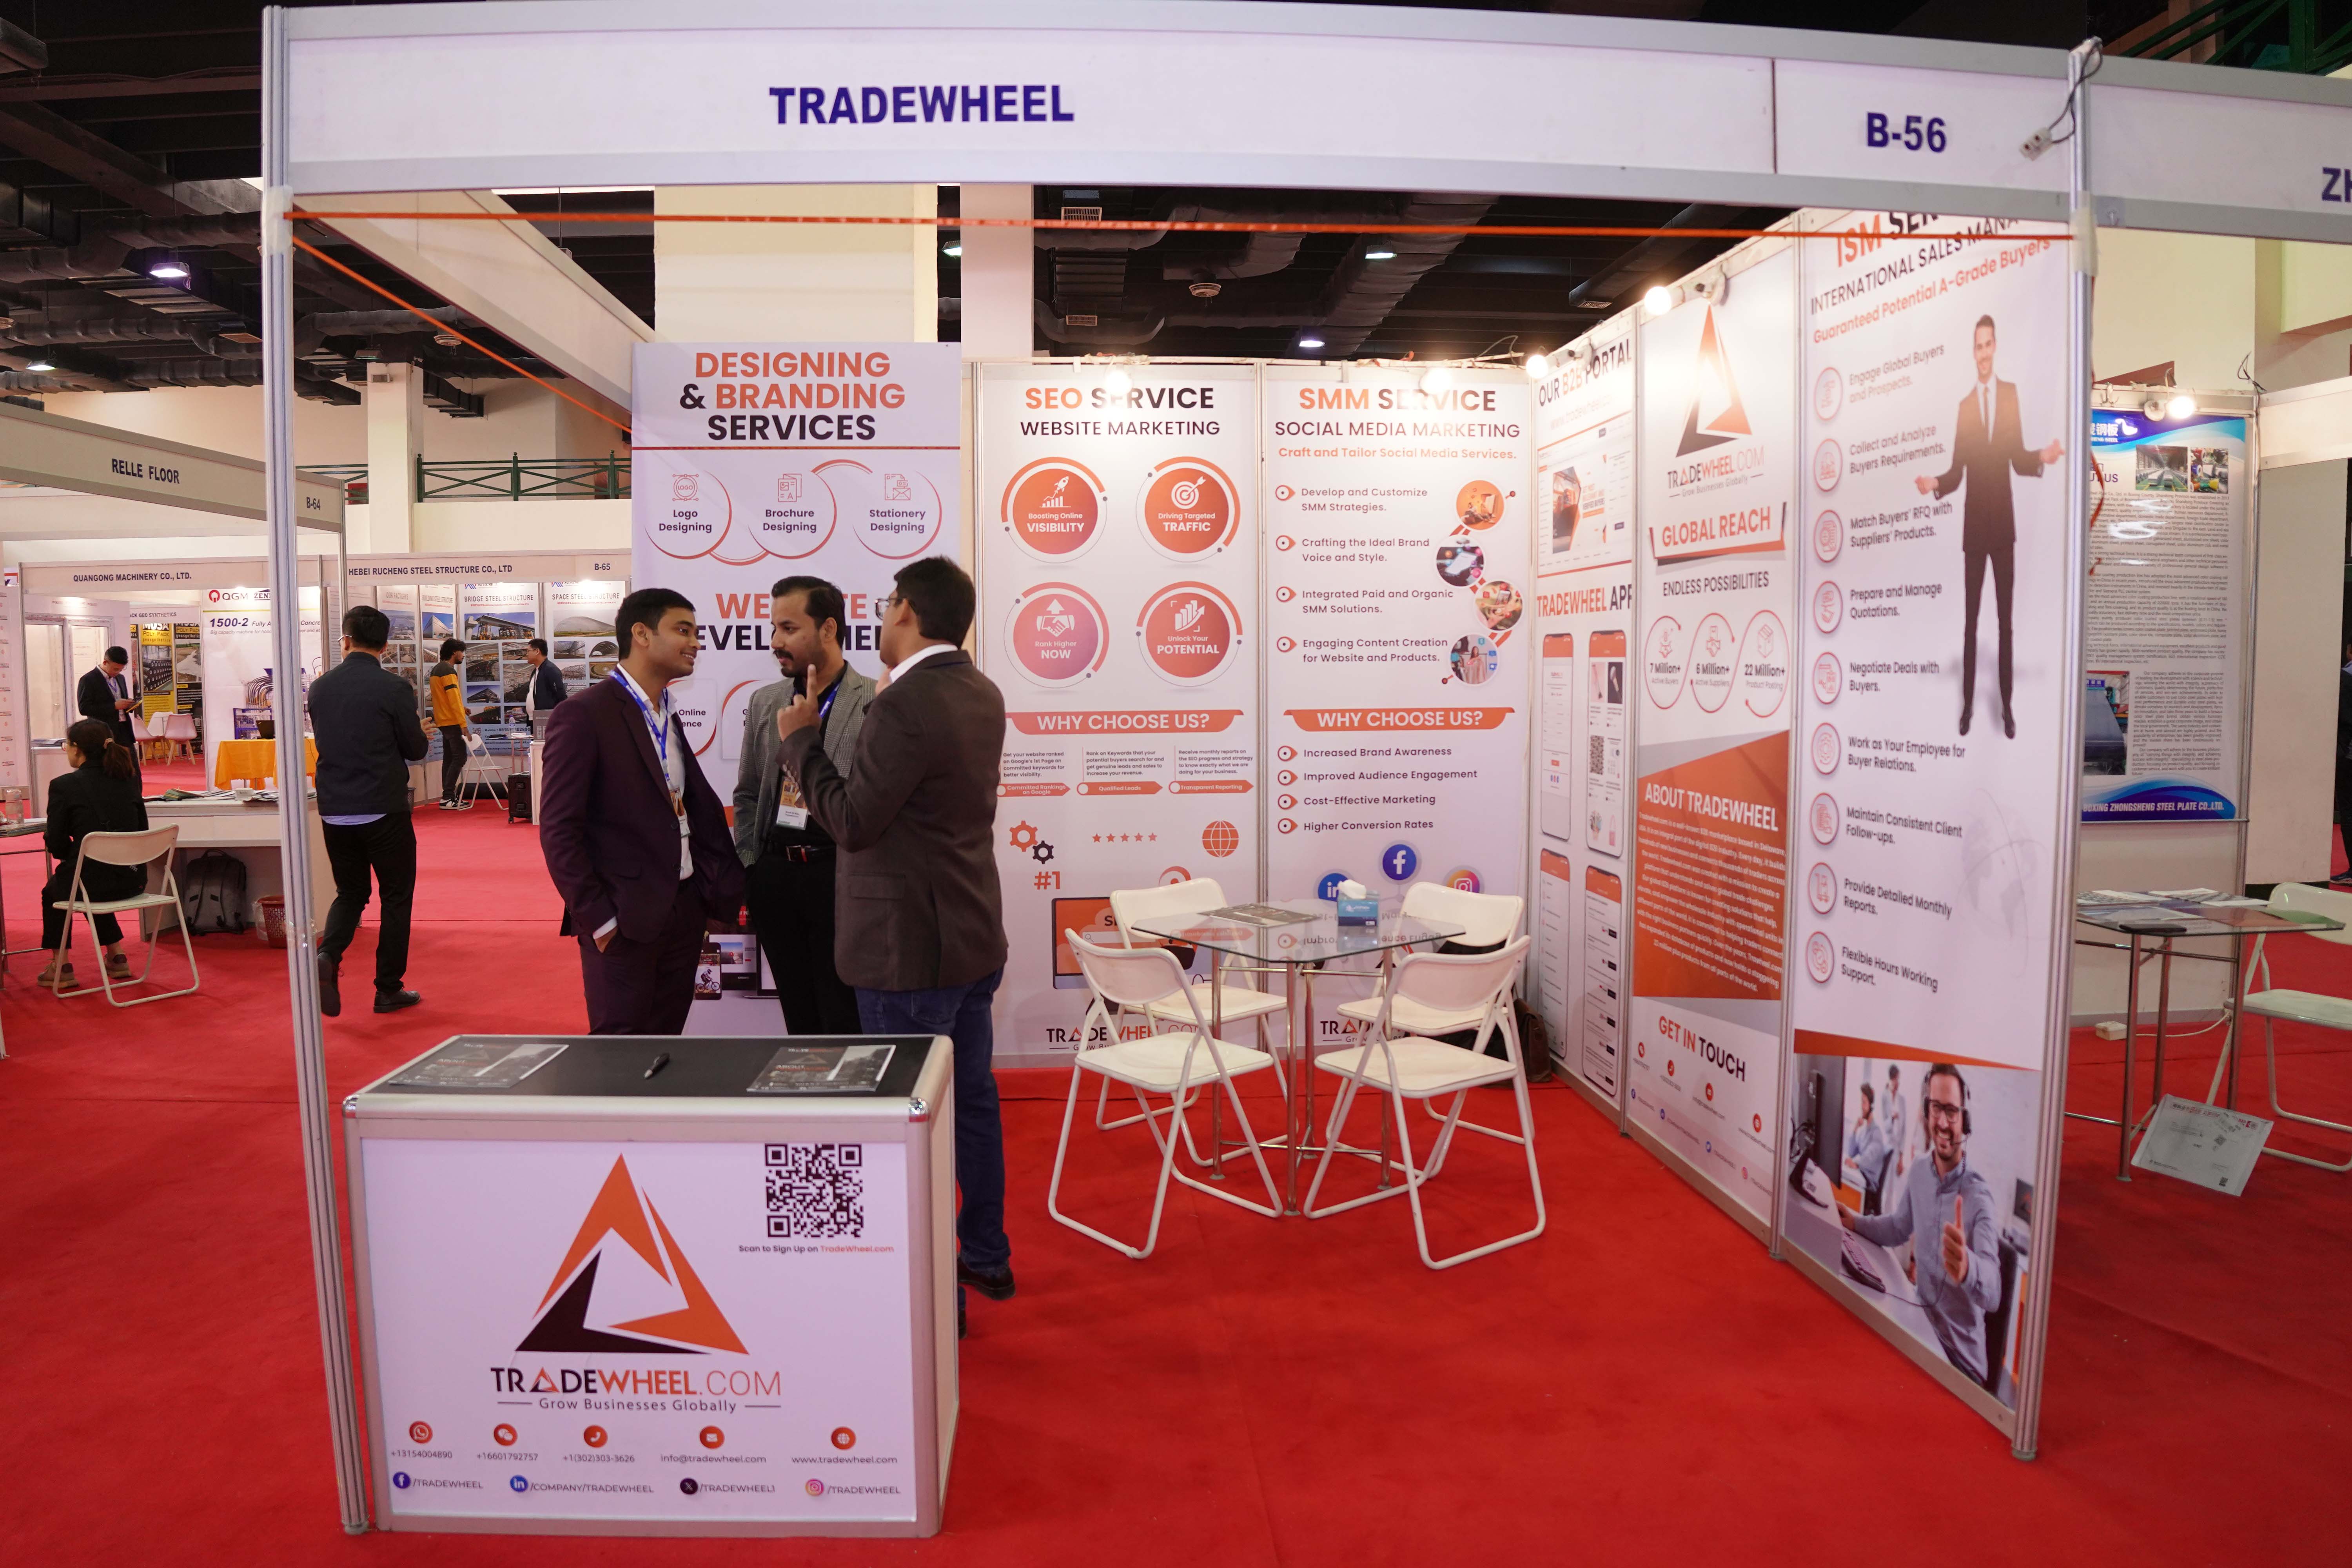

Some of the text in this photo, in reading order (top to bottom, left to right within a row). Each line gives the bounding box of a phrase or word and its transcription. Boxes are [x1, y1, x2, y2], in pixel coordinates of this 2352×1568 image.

[769, 85, 1074, 124] TRADEWHEEL
[1867, 112, 1947, 153] B-56
[1811, 230, 1963, 317] INTERNATIONAL SALES
[1813, 240, 2051, 343] Guaranteed Potential A-Grade Buyers
[696, 352, 890, 377] DESIGNING
[680, 383, 905, 409] & BRANDING
[1026, 388, 1082, 409] SEO
[1300, 388, 1368, 409] SMM
[708, 415, 875, 440] SERVICES
[1020, 421, 1220, 435] WEBSITE MARKETING
[1276, 422, 1520, 437] SOCIAL MEDIA MARKETING
[1279, 447, 1516, 459] Craft and Tailor Social Media Services.
[112, 459, 180, 484] RELLE FLOOR
[307, 497, 320, 510] B-64
[673, 510, 698, 520] Logo
[870, 509, 926, 520] Stationery
[659, 522, 711, 533] Designing
[763, 522, 816, 533] Designing
[871, 522, 924, 534] Designing
[1027, 523, 1084, 532] VISIBILITY
[1163, 522, 1210, 531] TRAFFIC
[1662, 506, 1770, 547] GLOBAL REACH
[482, 566, 496, 574] CO.,
[1663, 571, 1769, 596] ENDLESS POSSIBILITIES
[1303, 590, 1358, 601] Integrated
[1412, 590, 1453, 600] Organic
[1537, 588, 1607, 617] TRADEWHEEL
[1331, 604, 1382, 613] Solutions.
[210, 618, 248, 627] 1500-2
[1041, 650, 1071, 659] NOW
[1158, 644, 1219, 654] POTENTIAL
[1850, 661, 1939, 677] Negotiate Deals with
[1850, 680, 1880, 694] Buyers.
[1037, 713, 1209, 730] WHY CHOOSE US?
[1317, 711, 1483, 727] WHY CHOOSE US?
[1304, 749, 1356, 757] Increased
[1848, 737, 1965, 759] Work as Your Employee for
[1848, 754, 1916, 772] Buyer Relations.
[1645, 783, 1779, 832] ABOUT TRADEWHEEL
[2109, 803, 2155, 811] ZHONGSHENG
[2156, 802, 2175, 811] STEEL
[2177, 802, 2197, 810] PLATE
[1034, 871, 1060, 890] #1
[1659, 1016, 1745, 1082] GET IN TOUCH
[773, 1245, 791, 1254] Sign
[490, 1367, 780, 1395] TRADEWHEEL.COM
[539, 1398, 736, 1414] Grow Businesses Globally
[392, 1450, 452, 1458] +13154004890
[477, 1452, 538, 1461] +16601792757
[563, 1454, 635, 1463] +1(302)303-3626
[661, 1454, 766, 1464] info@tradewheel.com
[413, 1478, 483, 1488] /TRADEWHEEL
[827, 1486, 900, 1494] /TRADEWHEEL
